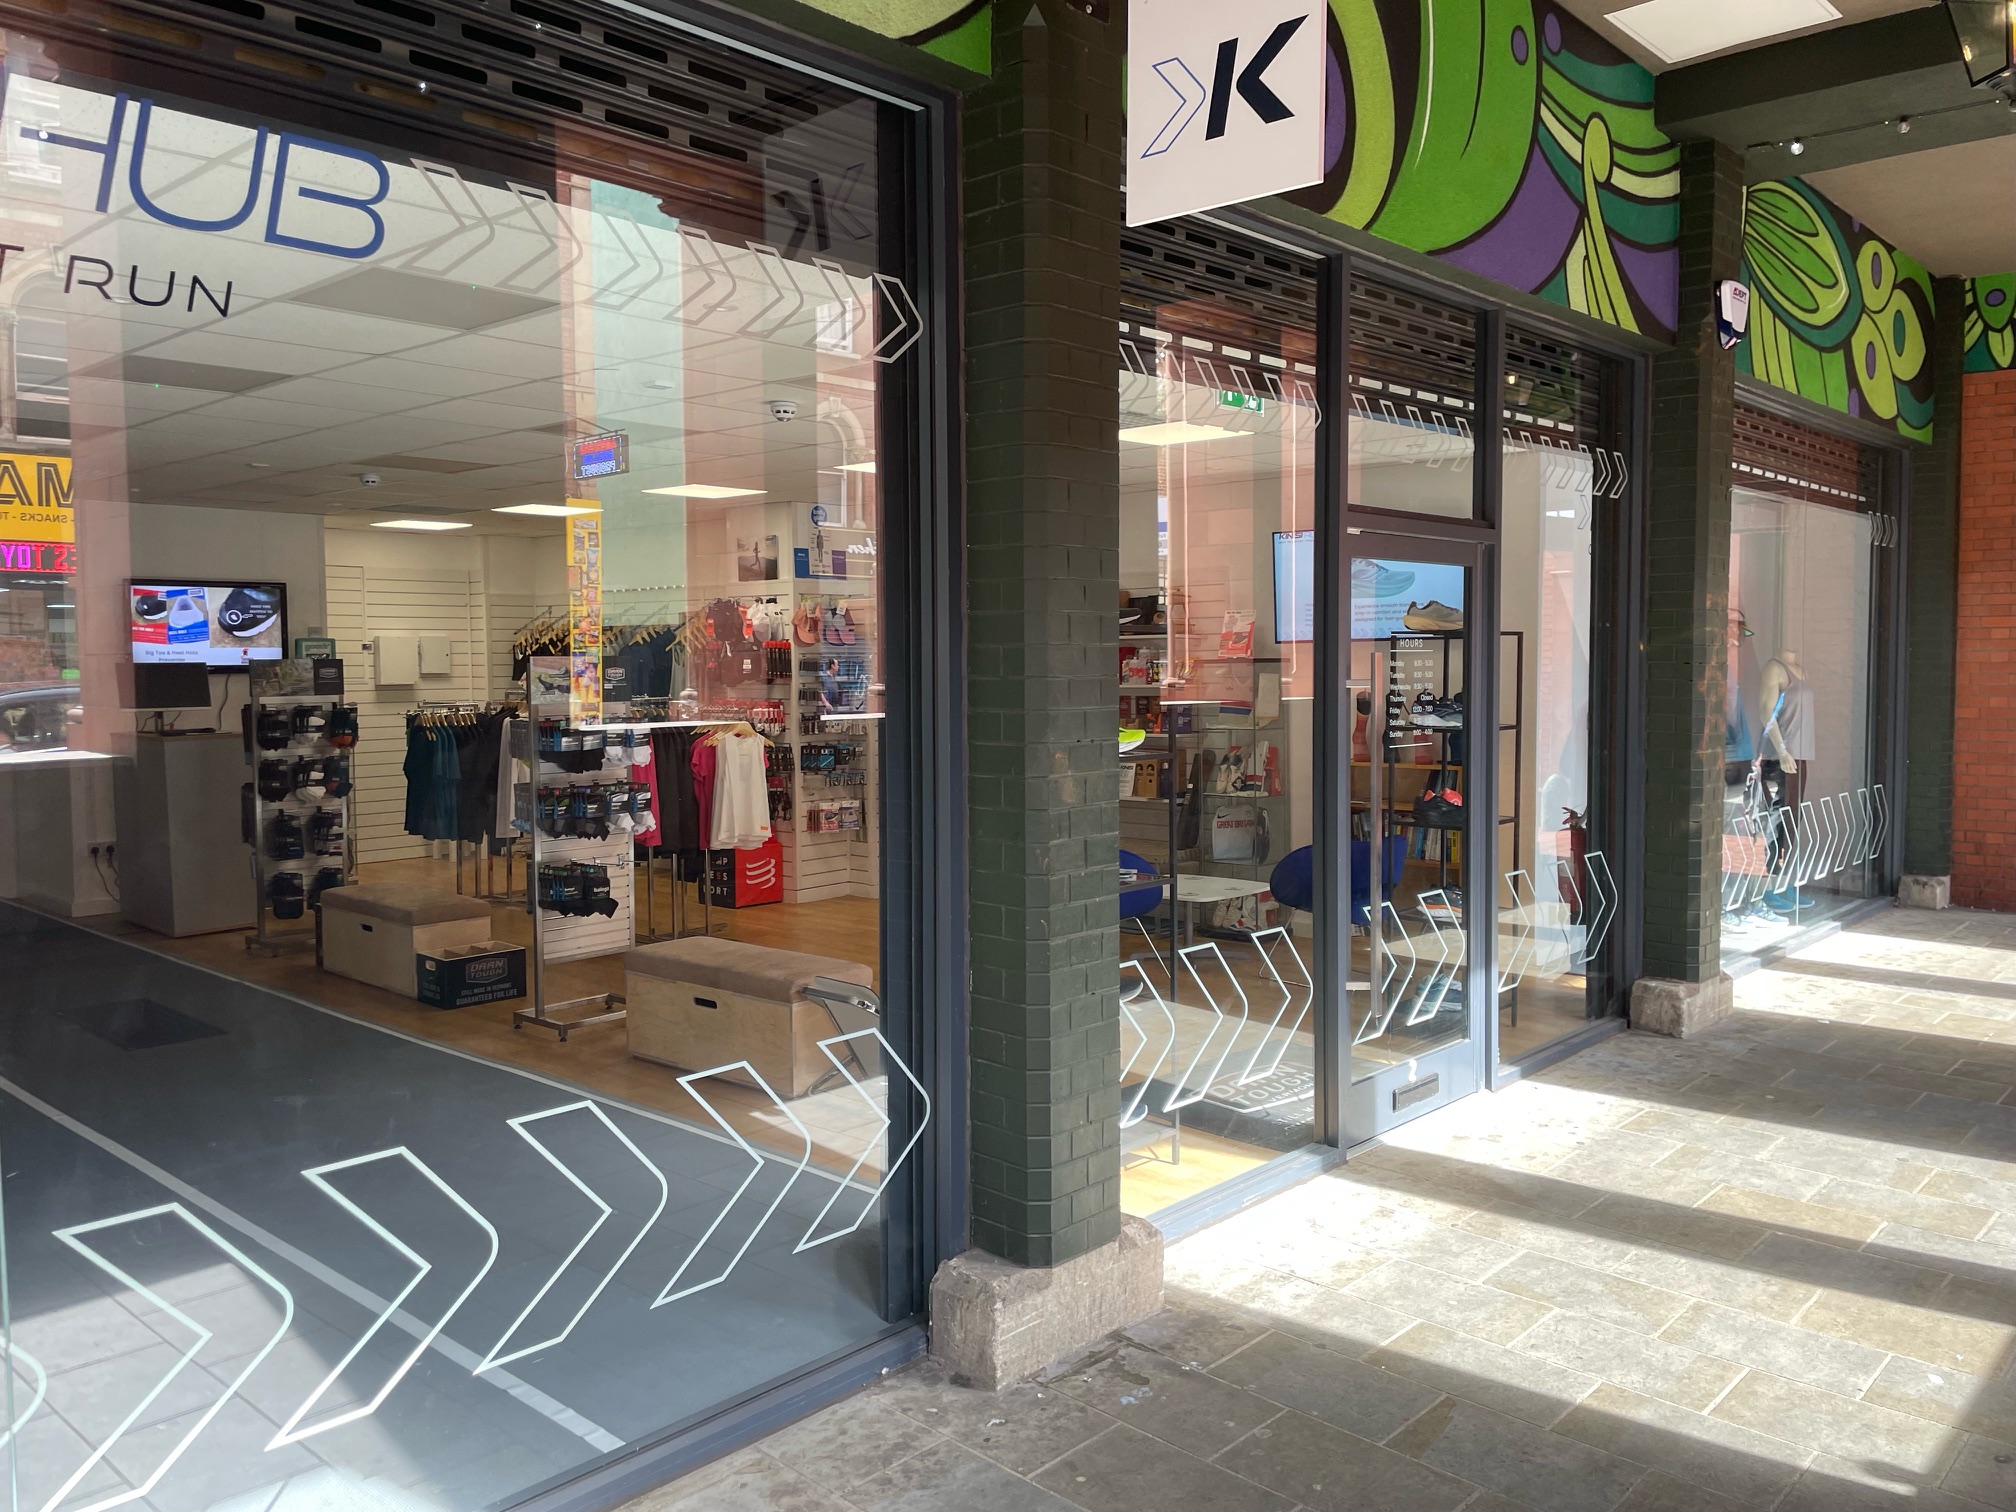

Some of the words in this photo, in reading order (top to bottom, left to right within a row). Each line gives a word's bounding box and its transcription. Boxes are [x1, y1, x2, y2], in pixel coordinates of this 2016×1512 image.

[1205, 13, 1309, 141] K
[0, 72, 390, 259] HUB
[64, 254, 234, 318] RUN
[305, 642, 331, 652] goodr
[1400, 639, 1424, 648] HOURS
[1390, 683, 1412, 691] Wednesday
[1390, 695, 1407, 703] Thursday
[1389, 707, 1401, 715] Friday
[1389, 730, 1404, 738] Sunday
[1217, 820, 1233, 829] GREAT
[1234, 819, 1256, 828] BRITAIN
[471, 960, 504, 972] DARN
[470, 969, 503, 979] TOUGH
[473, 986, 486, 994] MADE
[456, 994, 492, 1006] GUARANTEED
[493, 990, 505, 999] FOR
[505, 988, 518, 997] LIFE
